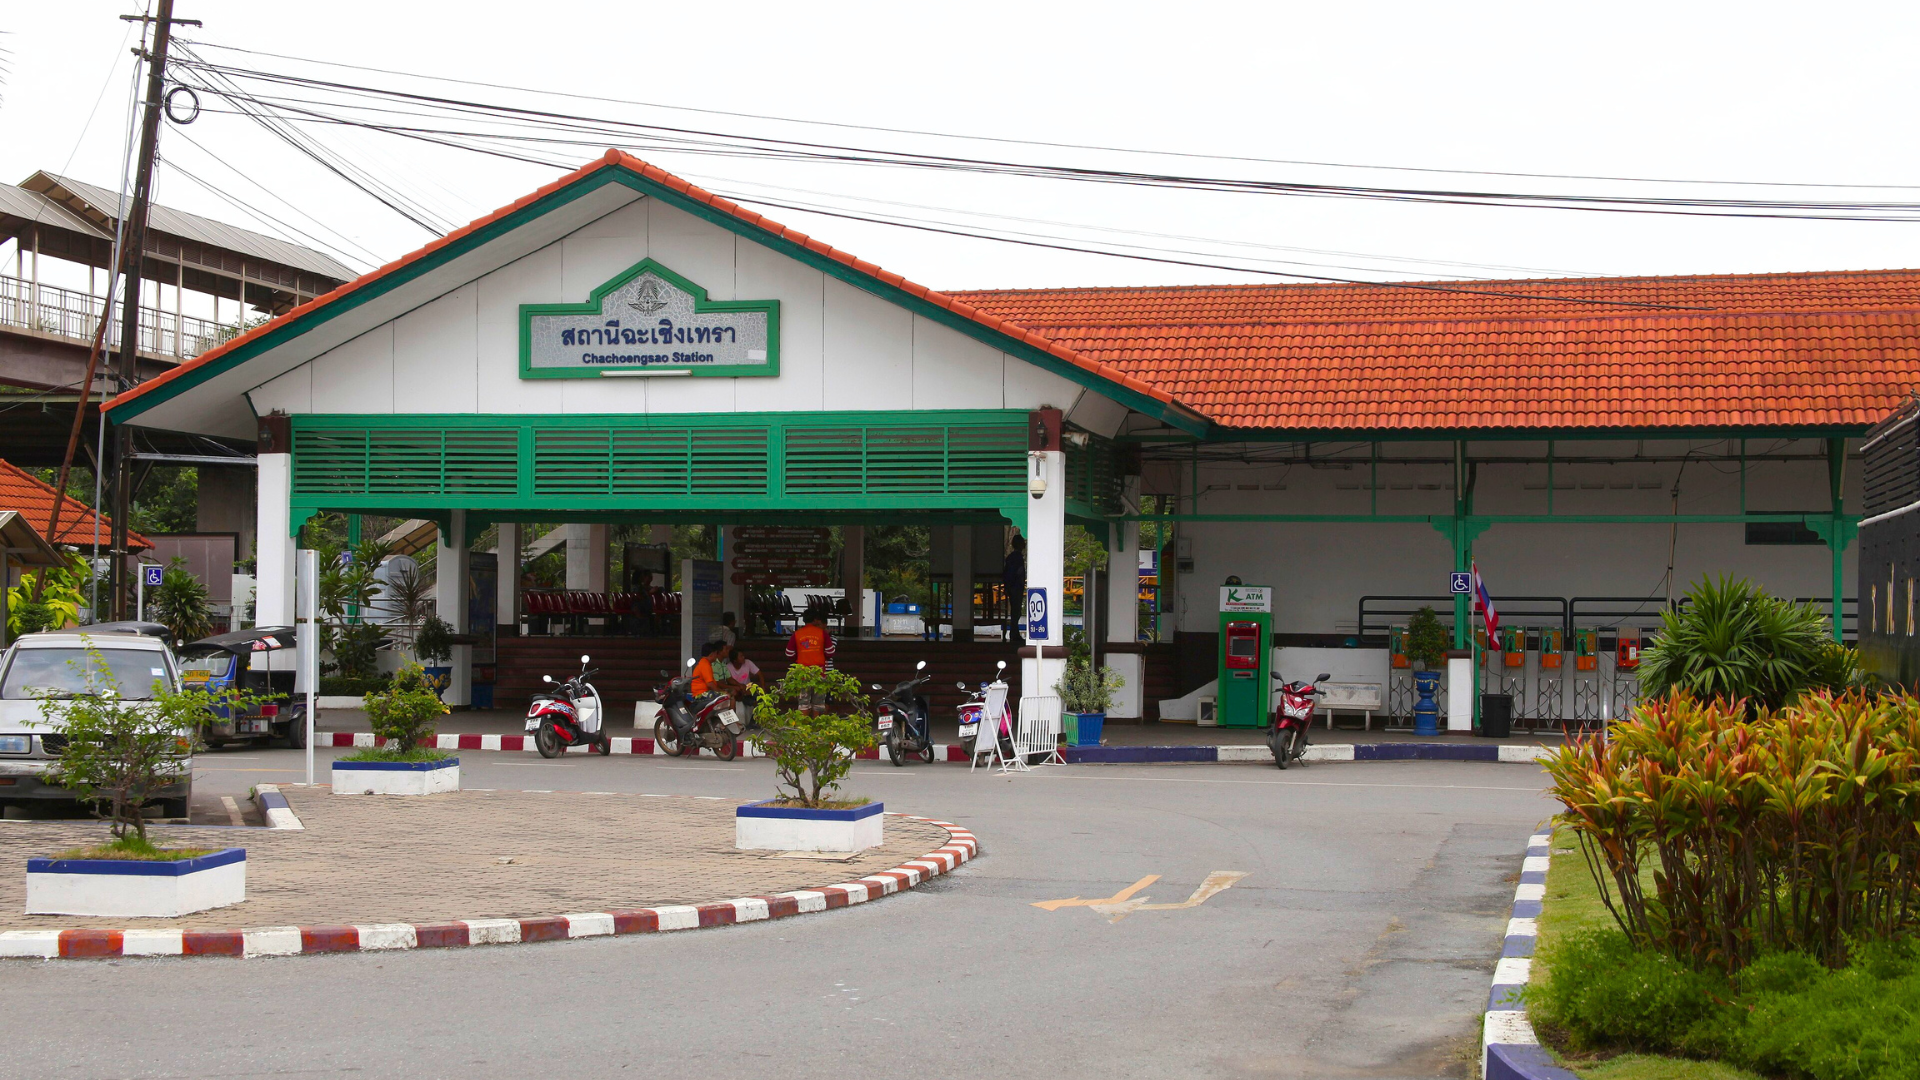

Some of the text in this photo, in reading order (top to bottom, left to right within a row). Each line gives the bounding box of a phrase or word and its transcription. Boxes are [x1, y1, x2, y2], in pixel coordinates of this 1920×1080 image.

[561, 319, 736, 346] สถานีฉะเชิงเทรา
[582, 352, 714, 366] Chachoengsao Station
[1227, 588, 1244, 602] K
